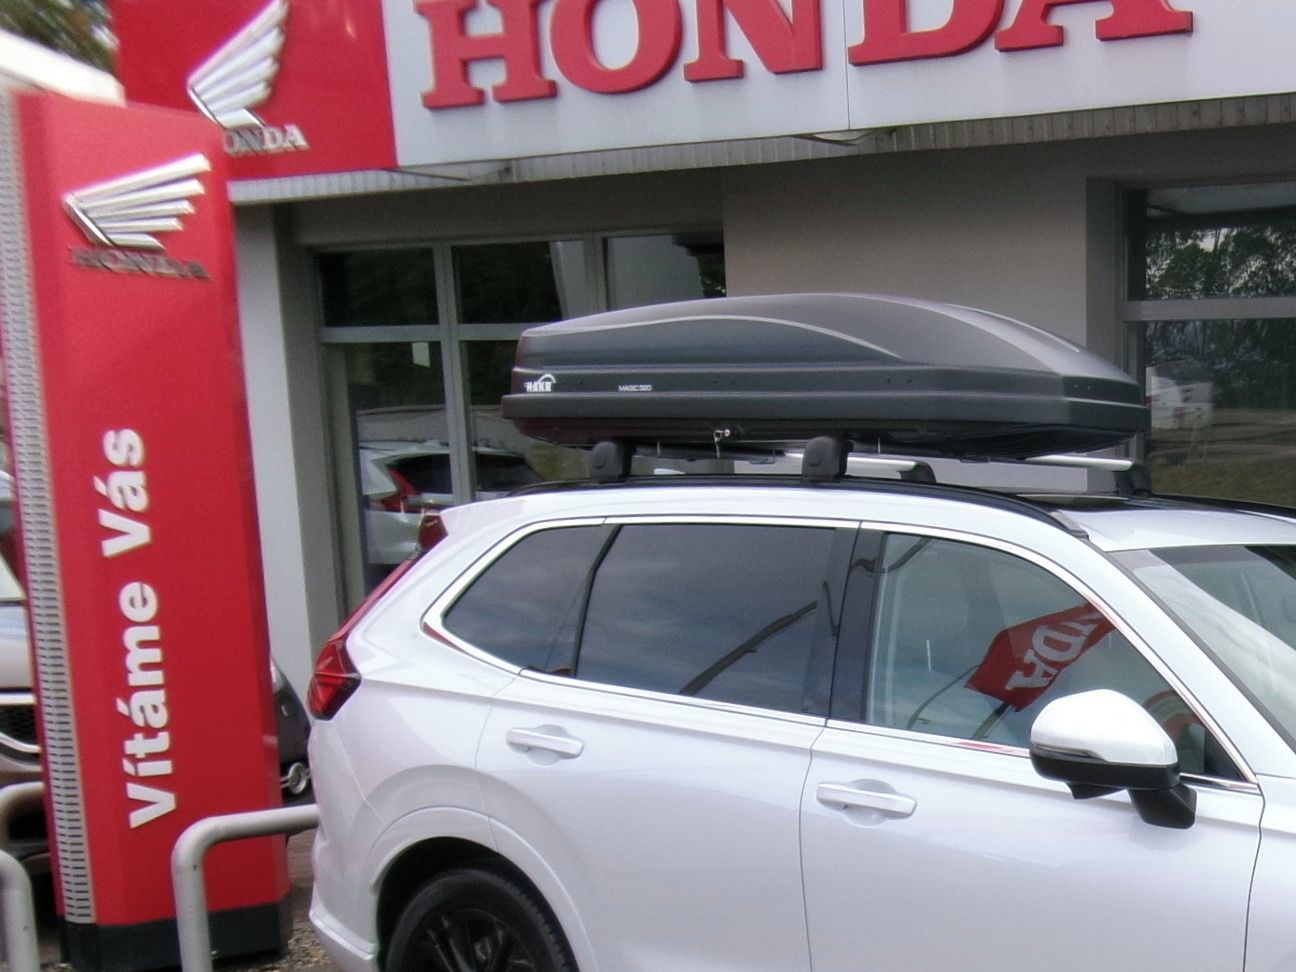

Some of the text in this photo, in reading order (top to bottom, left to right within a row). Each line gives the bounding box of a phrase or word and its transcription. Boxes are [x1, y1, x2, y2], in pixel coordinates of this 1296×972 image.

[224, 123, 310, 155] ONDA
[69, 246, 211, 281] HONDA
[95, 428, 177, 829] Vítáme Vás
